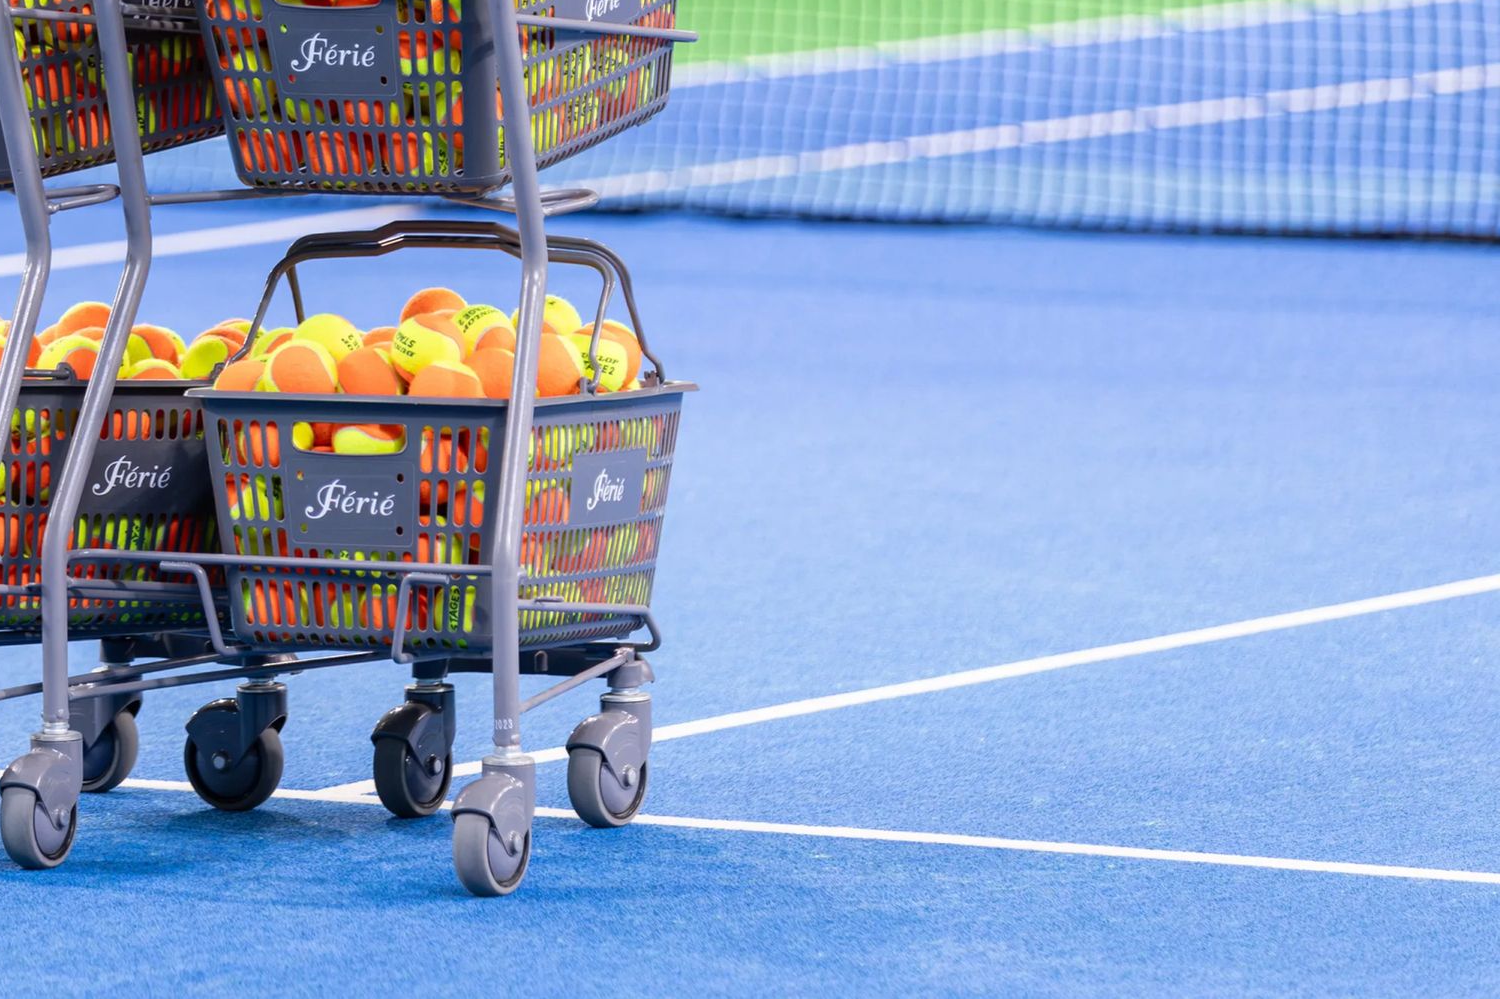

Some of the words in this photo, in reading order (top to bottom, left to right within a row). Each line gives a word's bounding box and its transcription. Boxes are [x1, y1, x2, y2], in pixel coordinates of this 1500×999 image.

[290, 32, 375, 72] Férié
[91, 455, 173, 496] Férié
[586, 468, 626, 510] Férié
[304, 479, 395, 519] Férié
